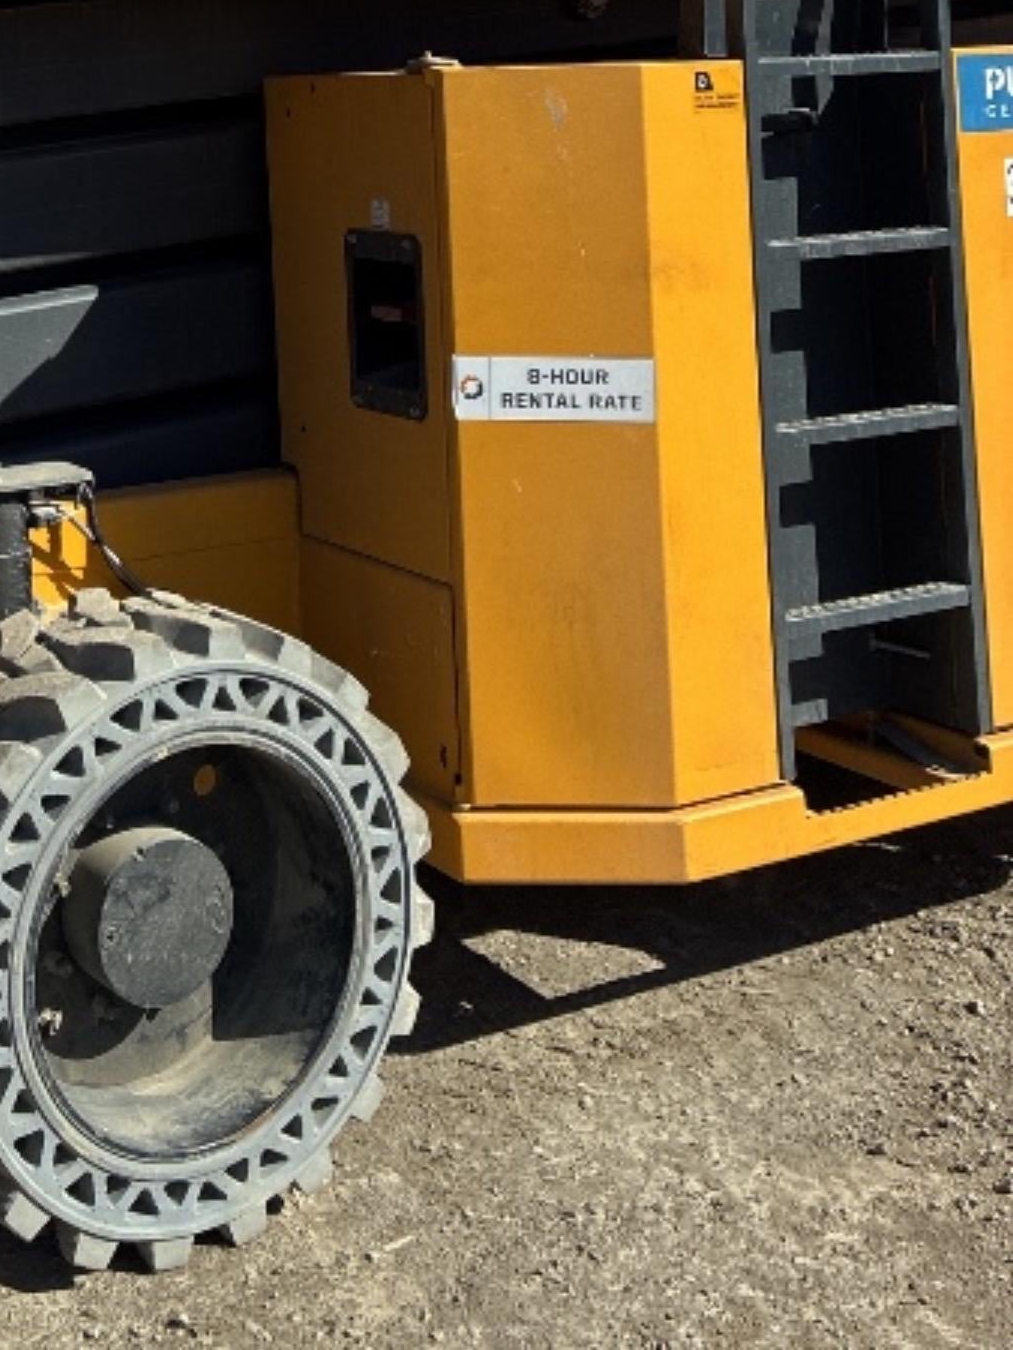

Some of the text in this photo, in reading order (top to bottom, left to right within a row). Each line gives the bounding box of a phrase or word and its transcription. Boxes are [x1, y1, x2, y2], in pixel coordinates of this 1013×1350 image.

[526, 368, 610, 386] 8-HOUR
[500, 392, 643, 411] RENTAL RATE
